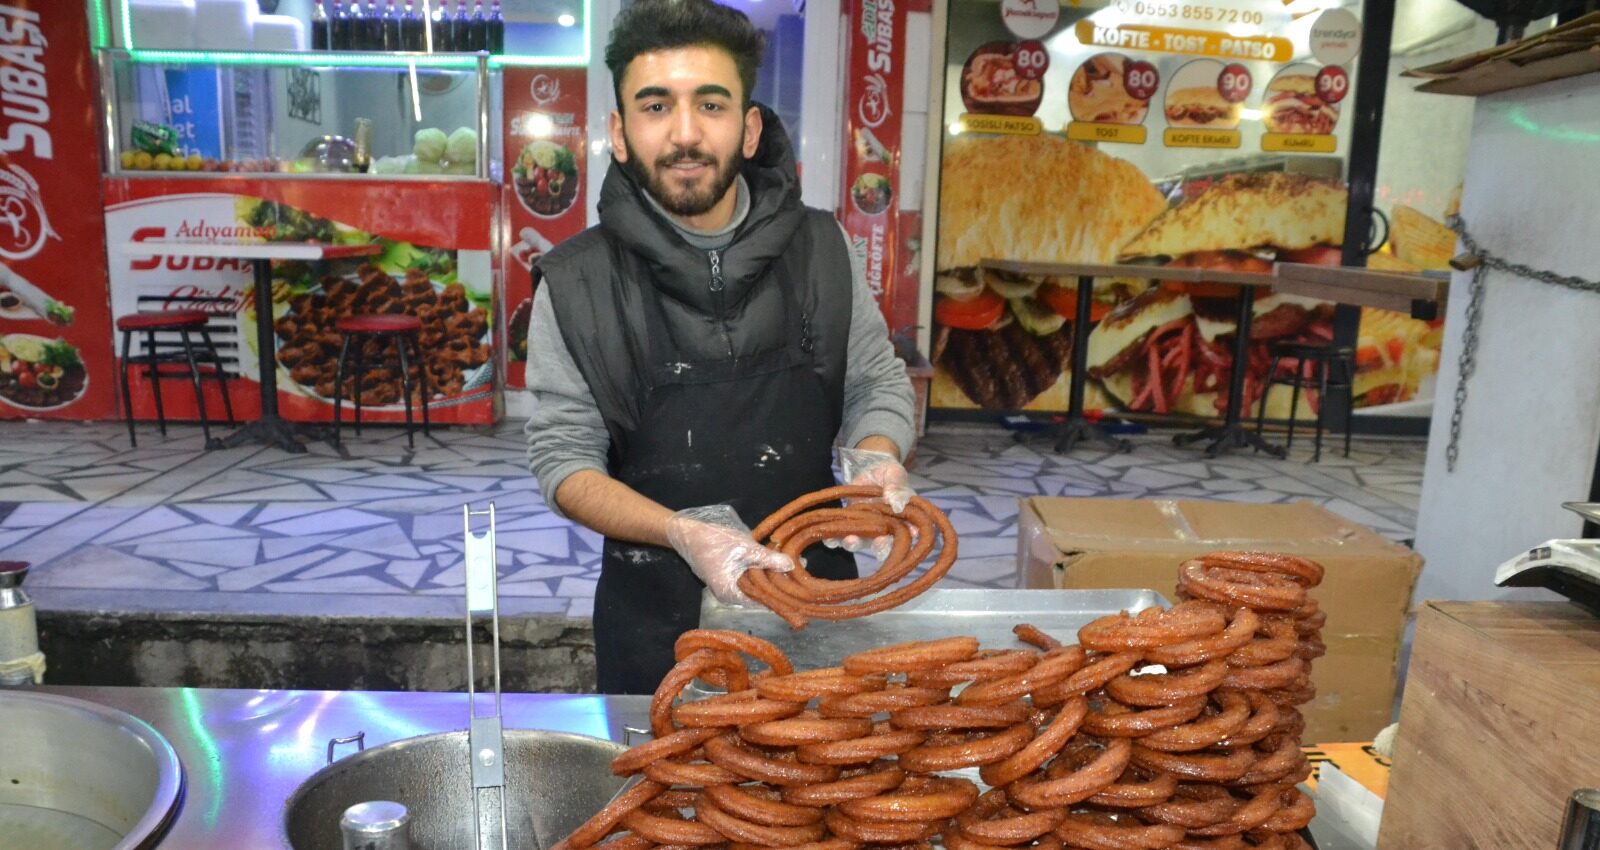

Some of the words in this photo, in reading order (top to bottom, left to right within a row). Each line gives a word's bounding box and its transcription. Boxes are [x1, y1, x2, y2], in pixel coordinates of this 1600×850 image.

[1136, 3, 1178, 17] 0553
[1183, 5, 1213, 20] 855
[1217, 9, 1238, 22] 72
[1242, 11, 1263, 25] 00
[1164, 33, 1207, 50] TOST
[1221, 38, 1275, 58] PATSO
[1018, 50, 1045, 68] 80
[1129, 70, 1156, 87] 80
[1223, 73, 1249, 91] 90
[1320, 74, 1346, 92] 90
[1096, 128, 1118, 137] TOST
